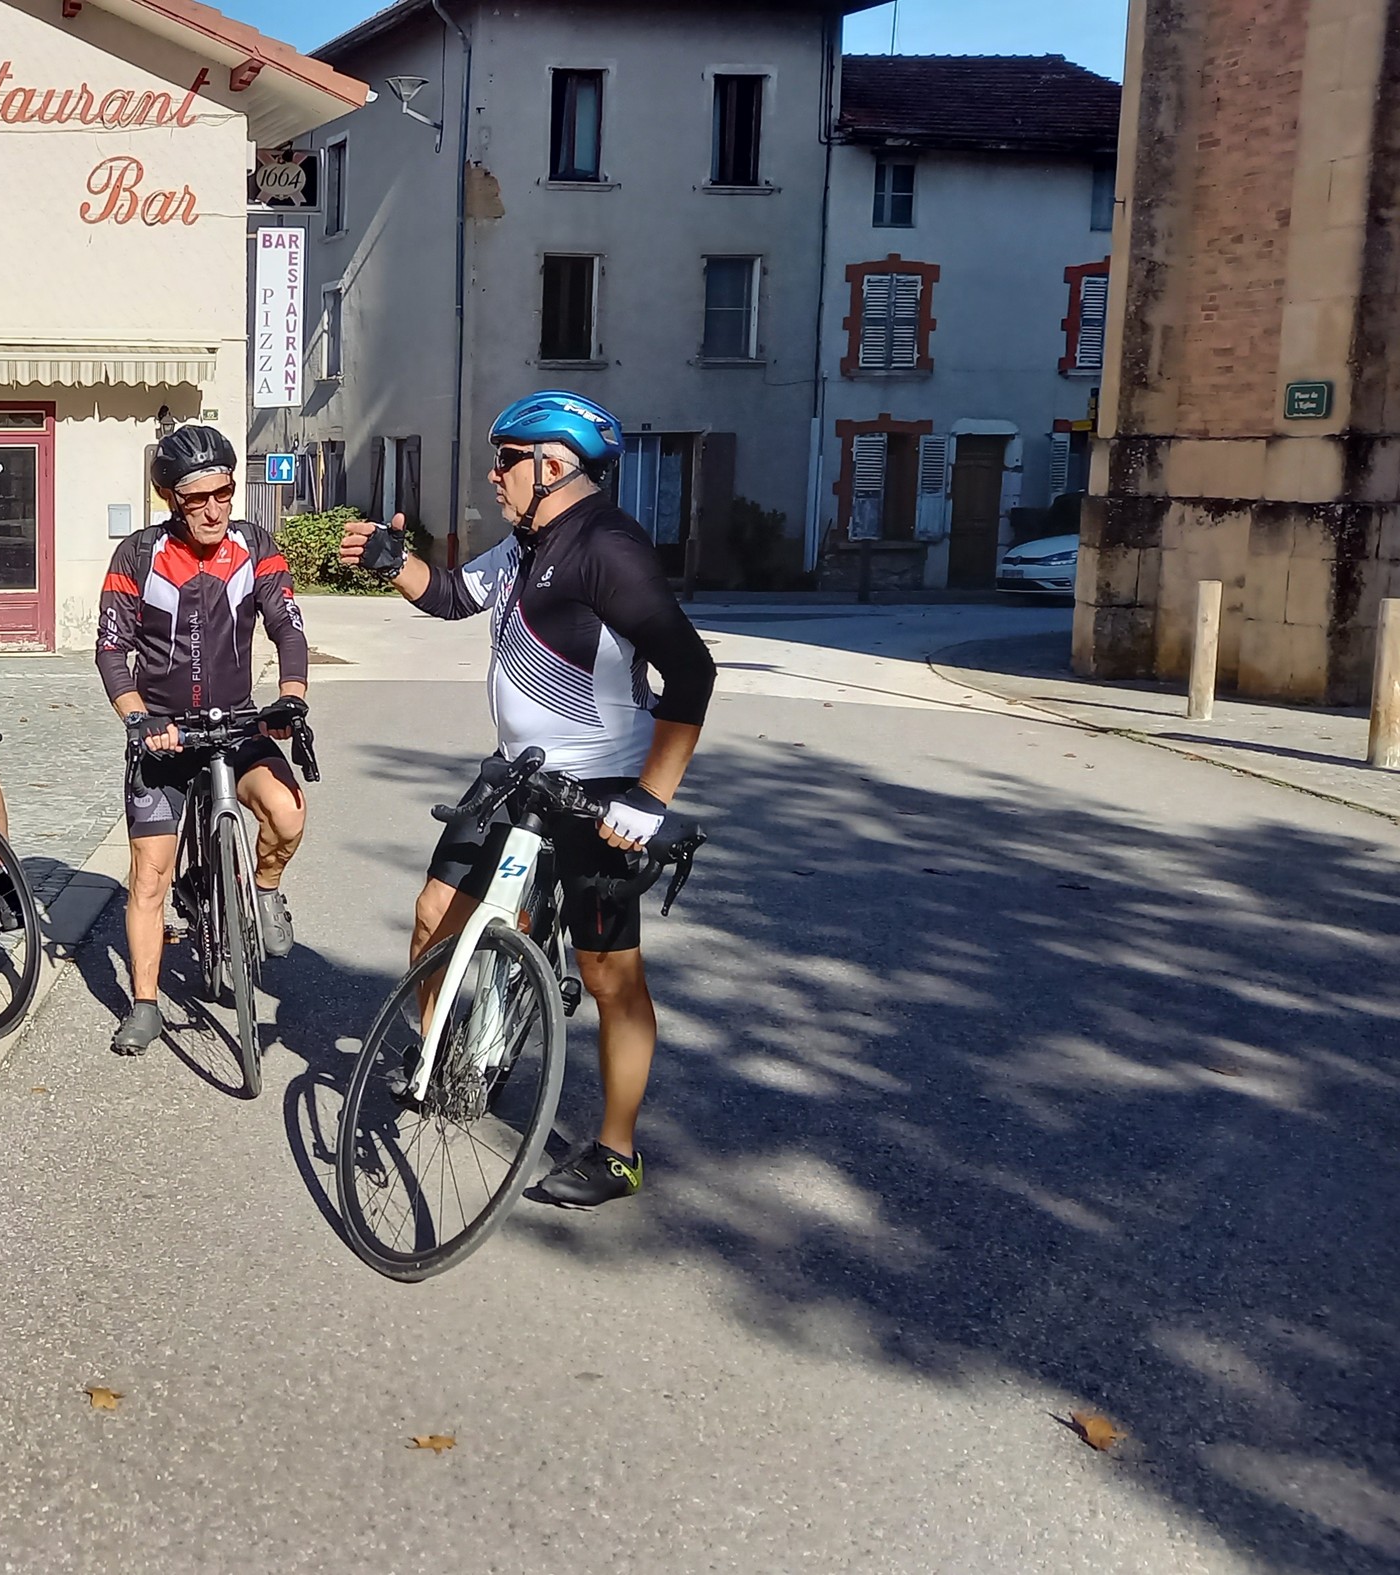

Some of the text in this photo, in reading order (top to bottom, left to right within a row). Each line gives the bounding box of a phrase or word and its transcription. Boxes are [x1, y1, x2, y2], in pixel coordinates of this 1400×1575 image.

[80, 155, 200, 227] Bar
[260, 166, 302, 189] 1664
[262, 233, 300, 249] BAR
[257, 288, 275, 395] PIZZA
[284, 233, 300, 402] RESTAURANT
[189, 610, 202, 708] PRO FUNCTIONAL
